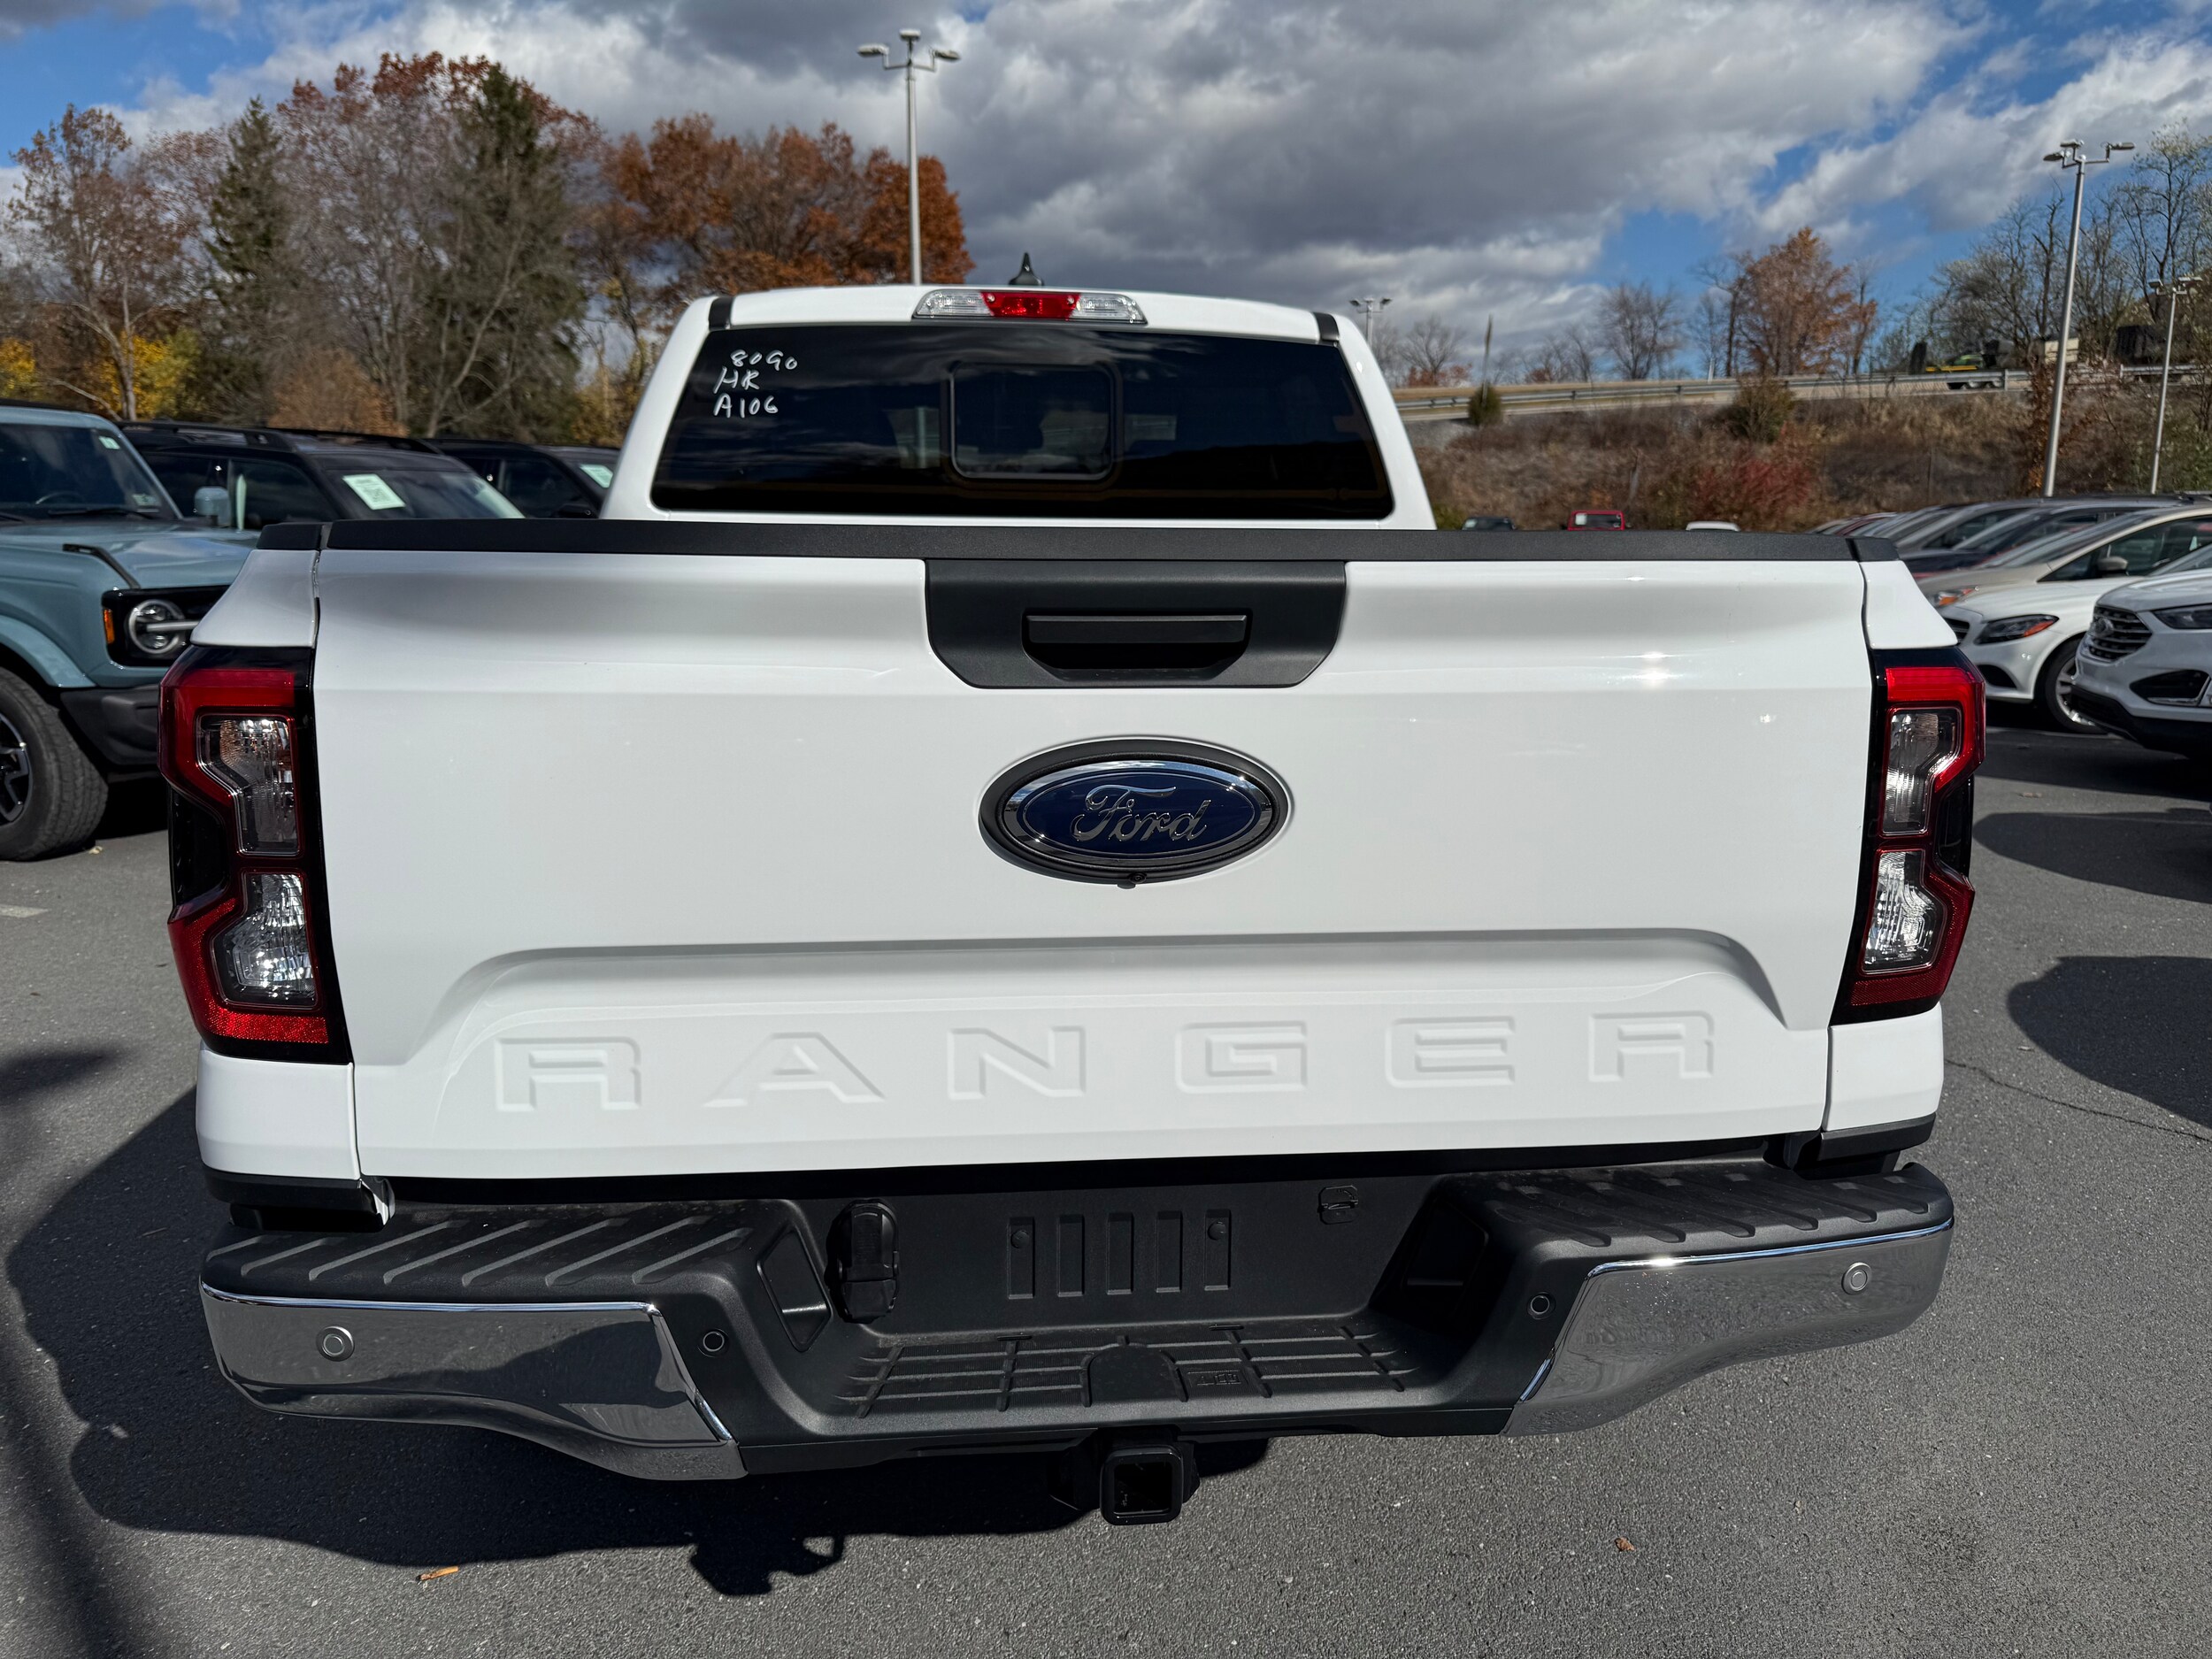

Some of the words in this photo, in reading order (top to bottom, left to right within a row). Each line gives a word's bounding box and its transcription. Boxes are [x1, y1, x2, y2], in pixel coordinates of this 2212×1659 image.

[713, 365, 760, 394] HR
[1071, 784, 1211, 841] Ford
[494, 1010, 1715, 1112] RANGER
